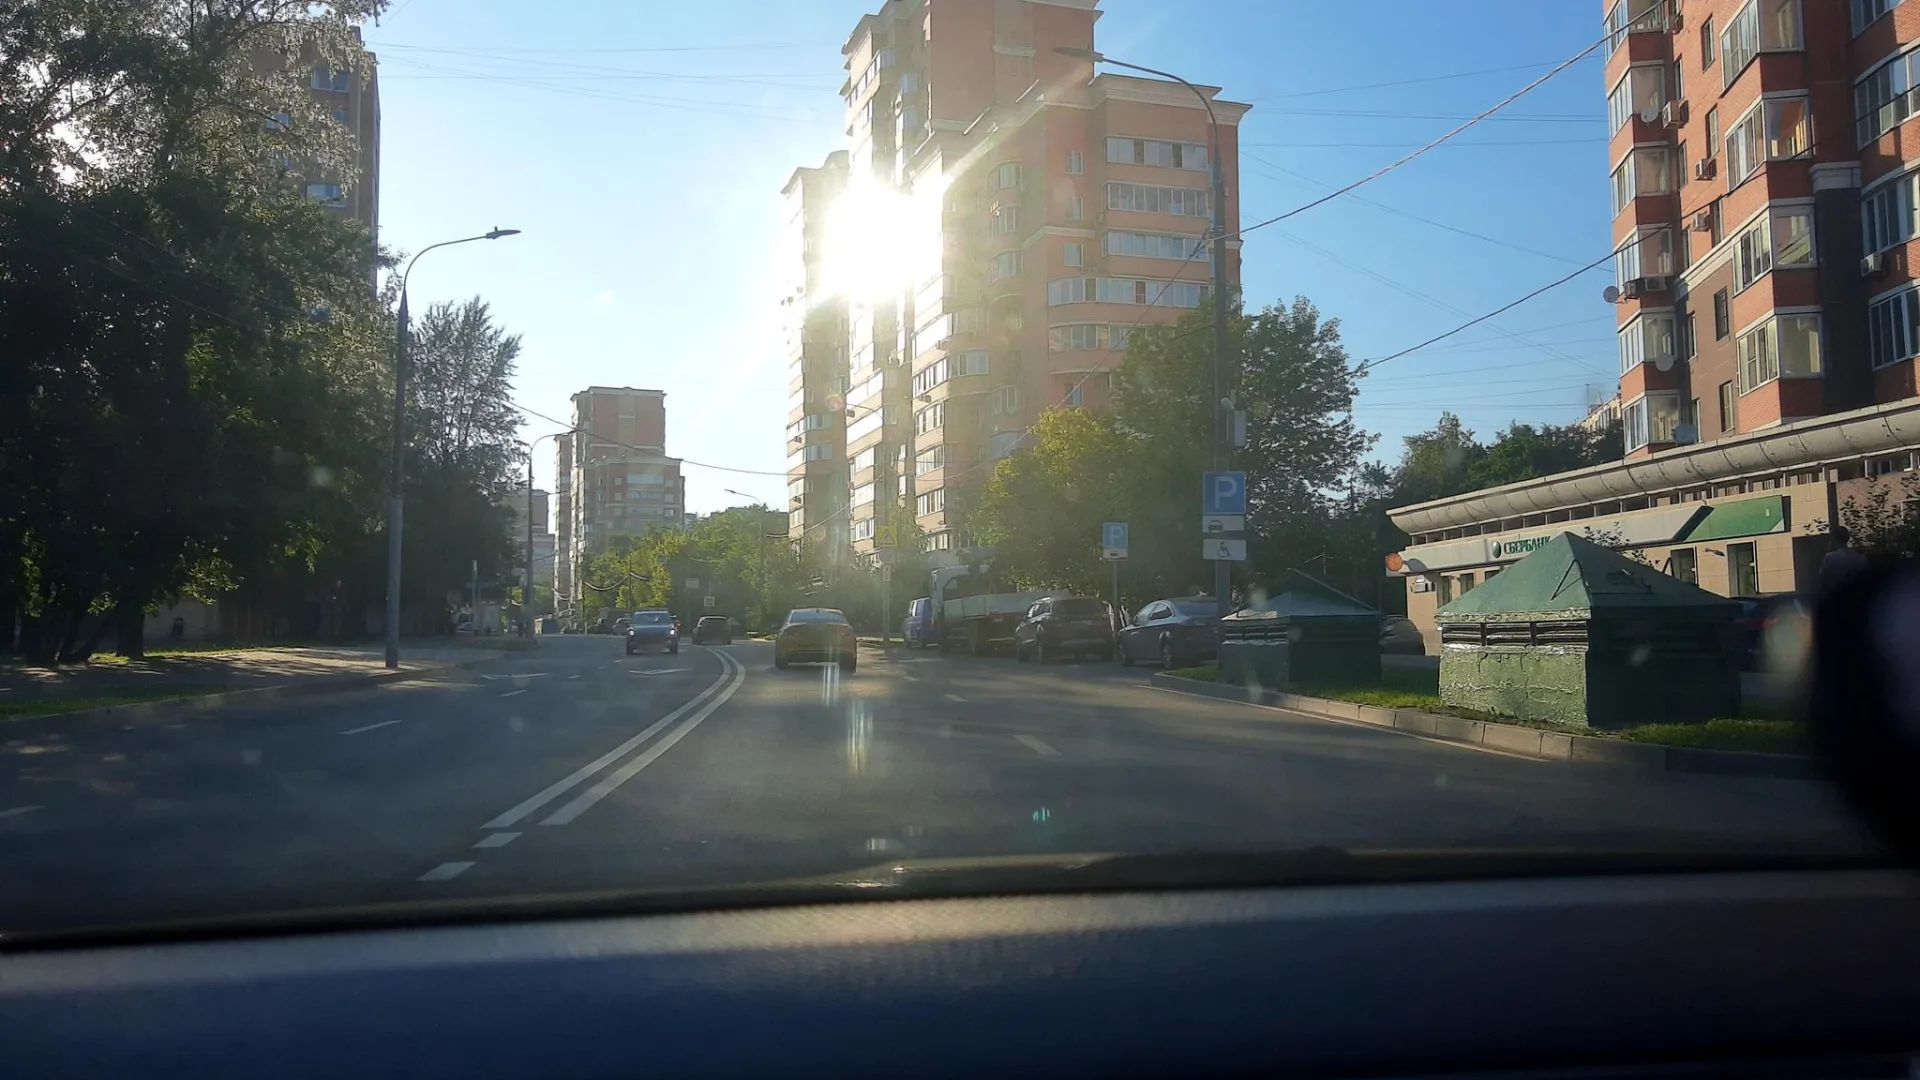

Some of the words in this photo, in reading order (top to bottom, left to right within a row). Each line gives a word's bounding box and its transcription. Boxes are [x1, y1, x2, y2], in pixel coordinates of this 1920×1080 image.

[1215, 476, 1237, 509] P
[1110, 526, 1123, 545] P
[1504, 536, 1551, 554] СБЕРБАНК
